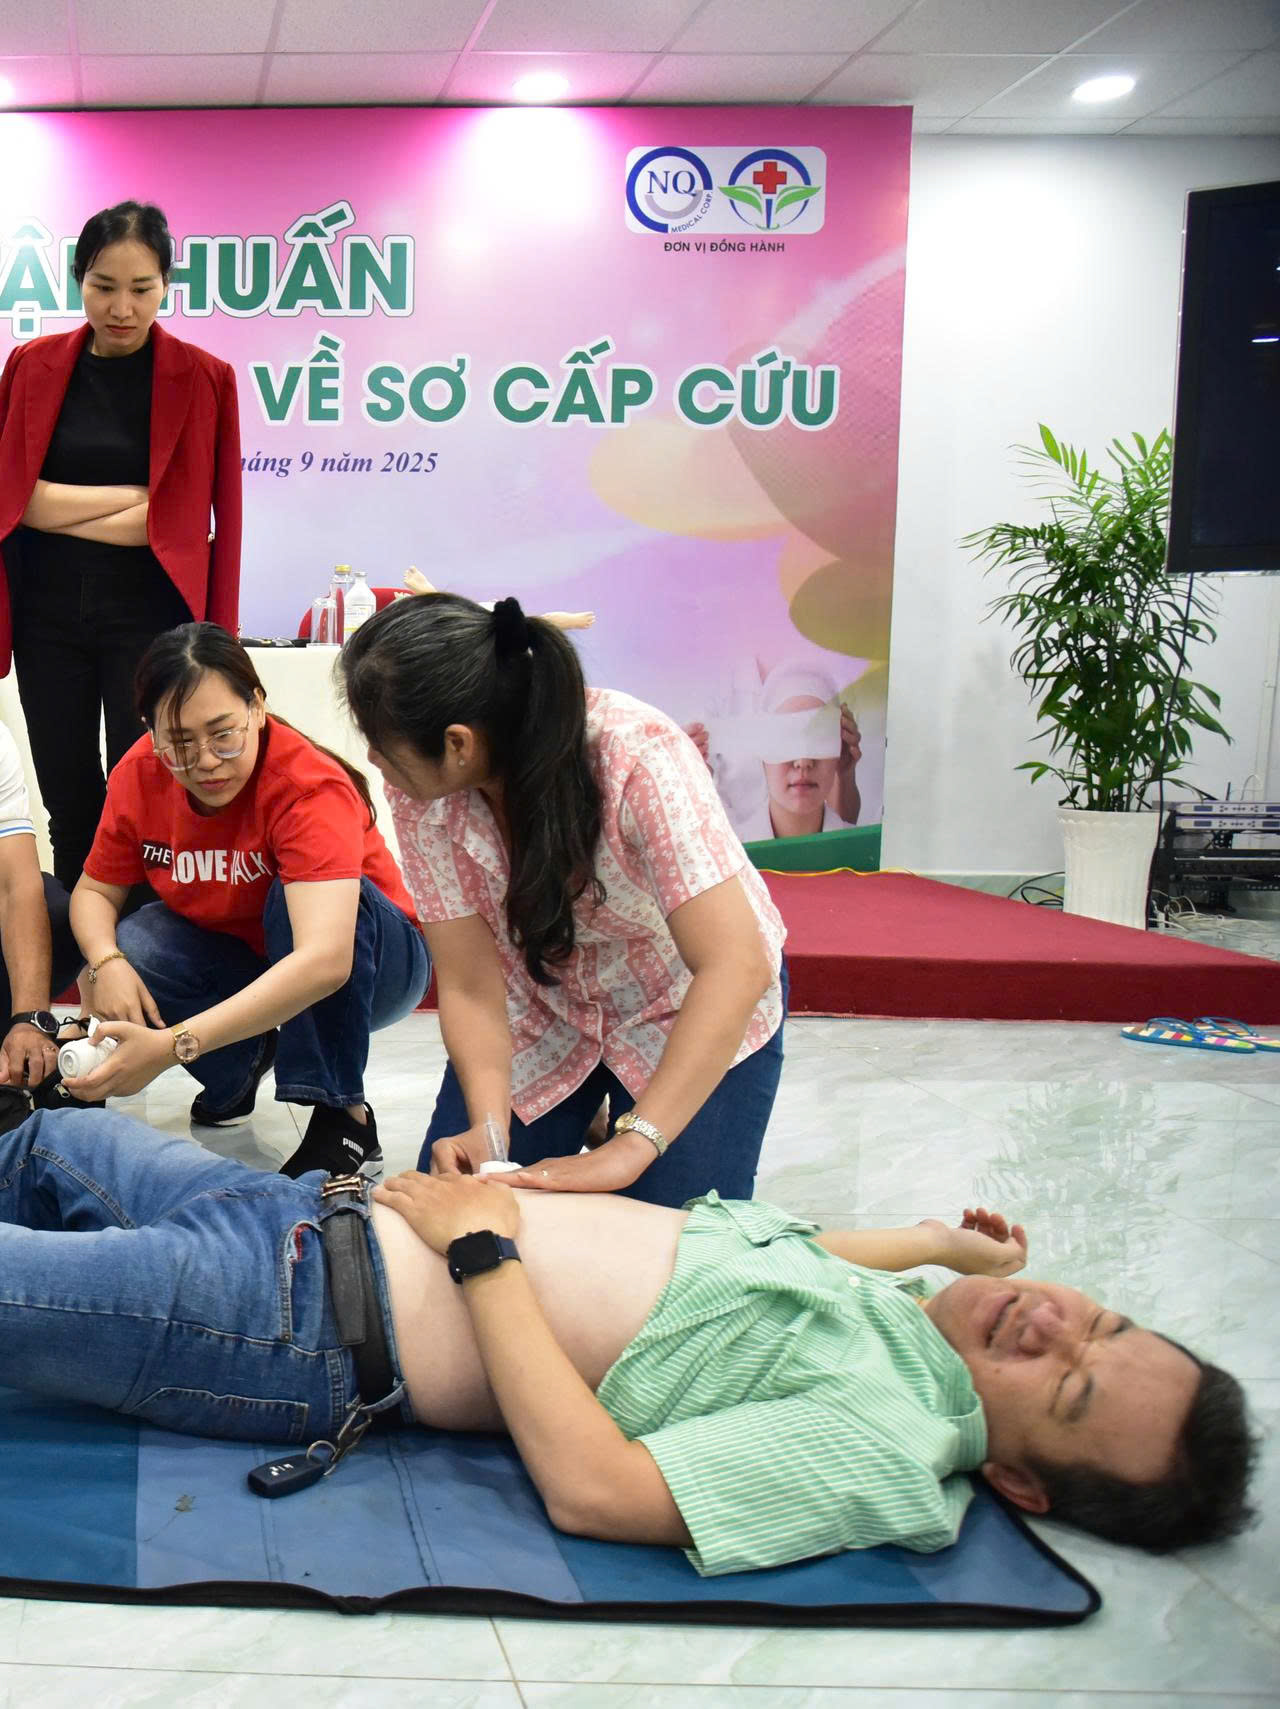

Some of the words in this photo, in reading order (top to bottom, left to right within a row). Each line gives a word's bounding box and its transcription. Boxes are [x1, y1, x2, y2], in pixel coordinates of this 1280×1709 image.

[647, 170, 697, 197] NQ
[671, 214, 702, 233] MEDICAL
[663, 241, 691, 252] ĐƠN
[694, 242, 706, 253] VỊ
[709, 238, 746, 252] ĐỒNG
[750, 240, 785, 252] HÀNH
[159, 208, 408, 311] HUẤN
[252, 335, 340, 422] VỀ
[367, 358, 468, 423] SƠ
[493, 340, 654, 424] CẤP
[677, 351, 836, 427] CỨU
[241, 451, 293, 478] áng
[299, 451, 314, 473] 9
[320, 452, 373, 473] năm
[380, 452, 439, 473] 2025
[143, 844, 172, 865] THE
